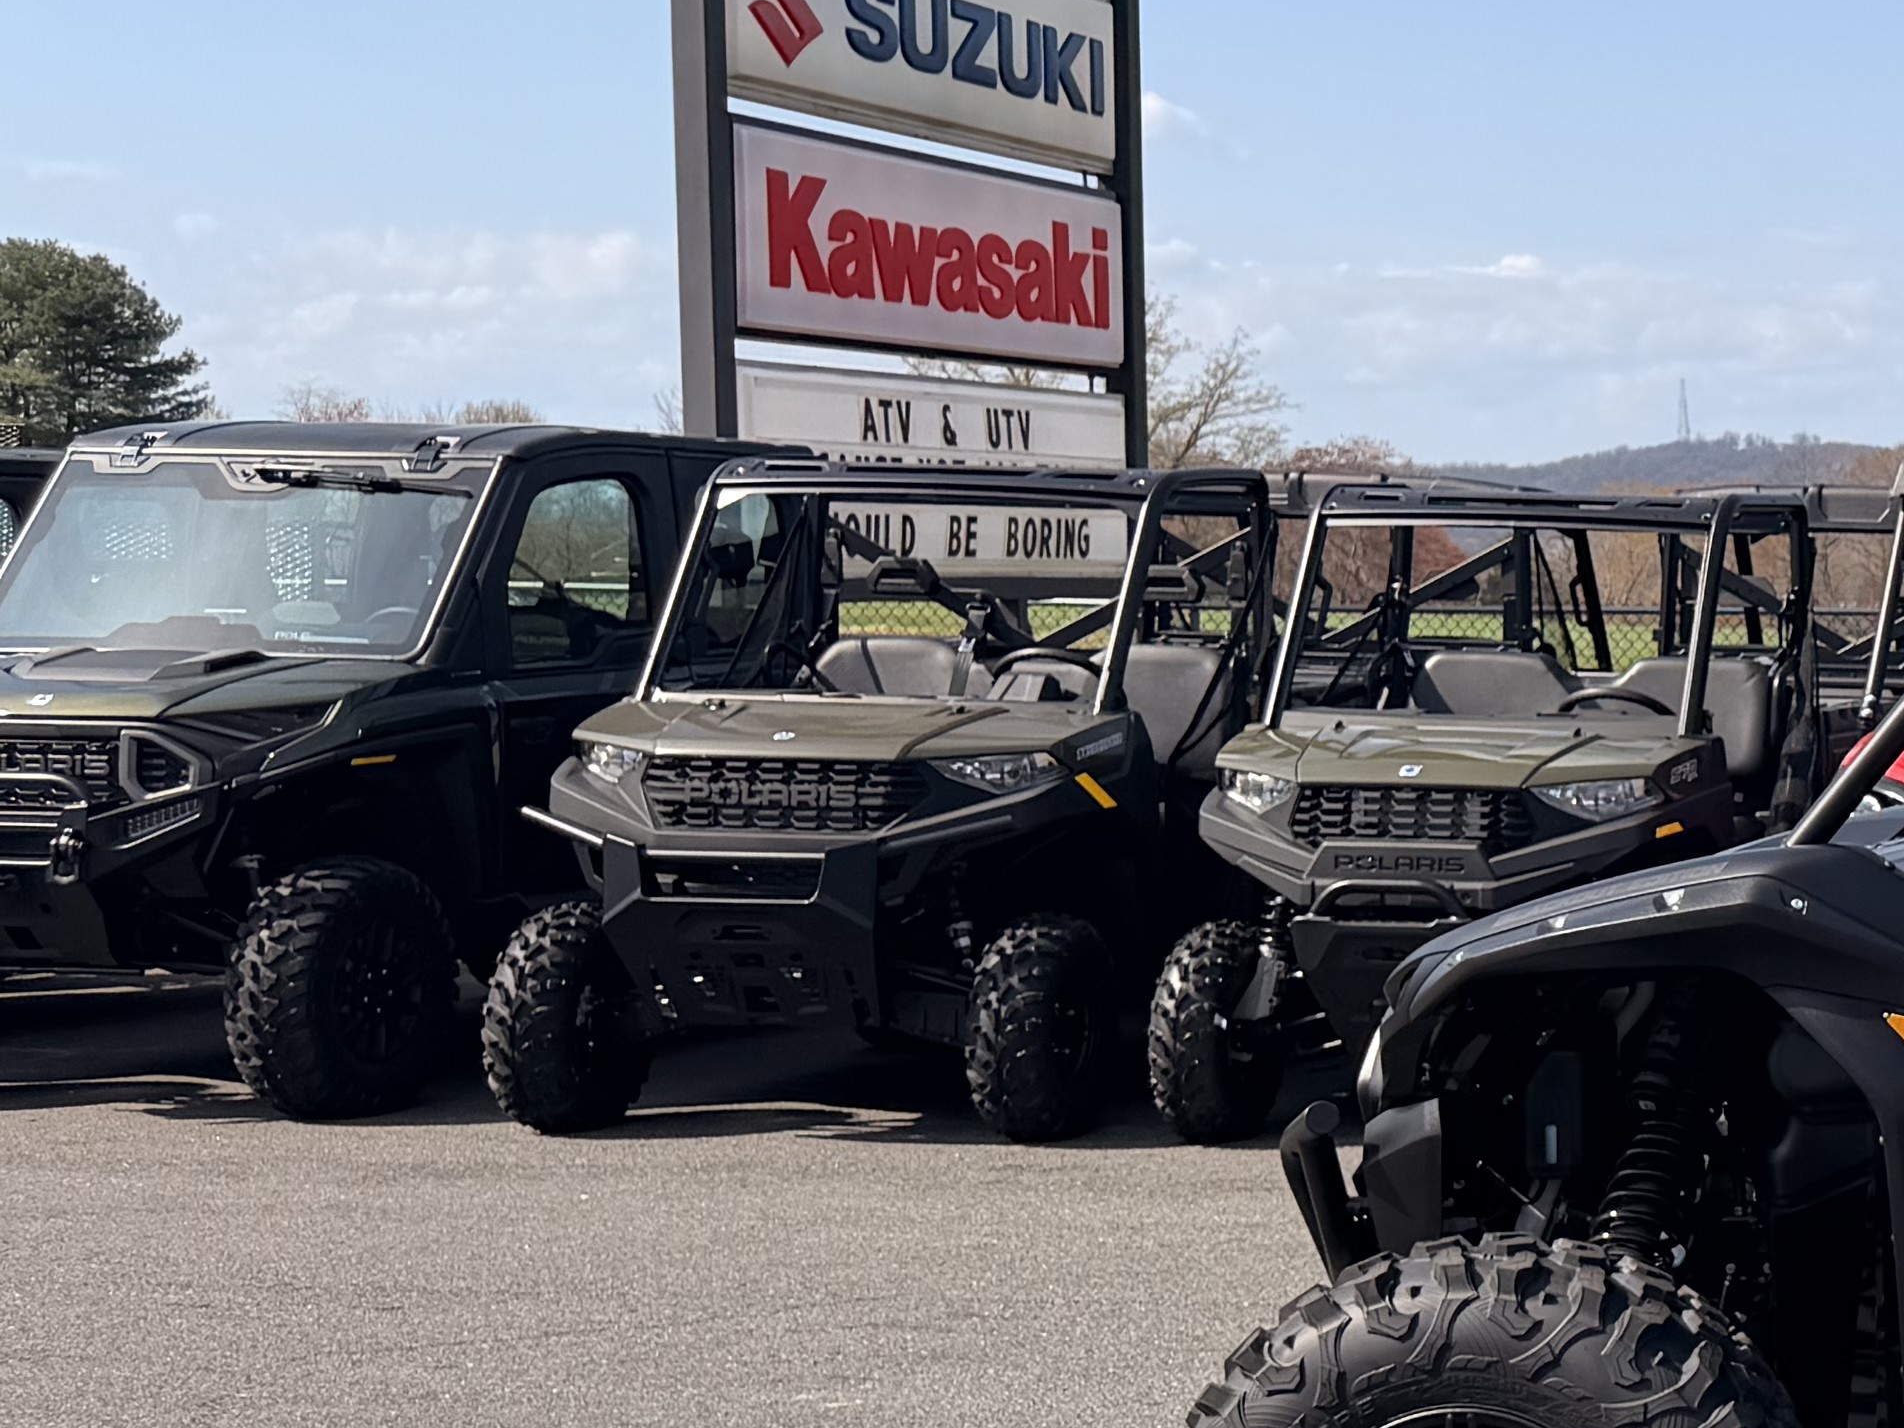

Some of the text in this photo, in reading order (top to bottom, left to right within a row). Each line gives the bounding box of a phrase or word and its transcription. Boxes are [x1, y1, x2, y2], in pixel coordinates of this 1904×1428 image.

[766, 167, 1109, 330] Kawasaki
[862, 397, 1030, 451] ATV & UTV
[833, 512, 1090, 558] ULD BE BORING
[684, 779, 857, 810] POLARIS
[1334, 854, 1465, 875] POLARIS
